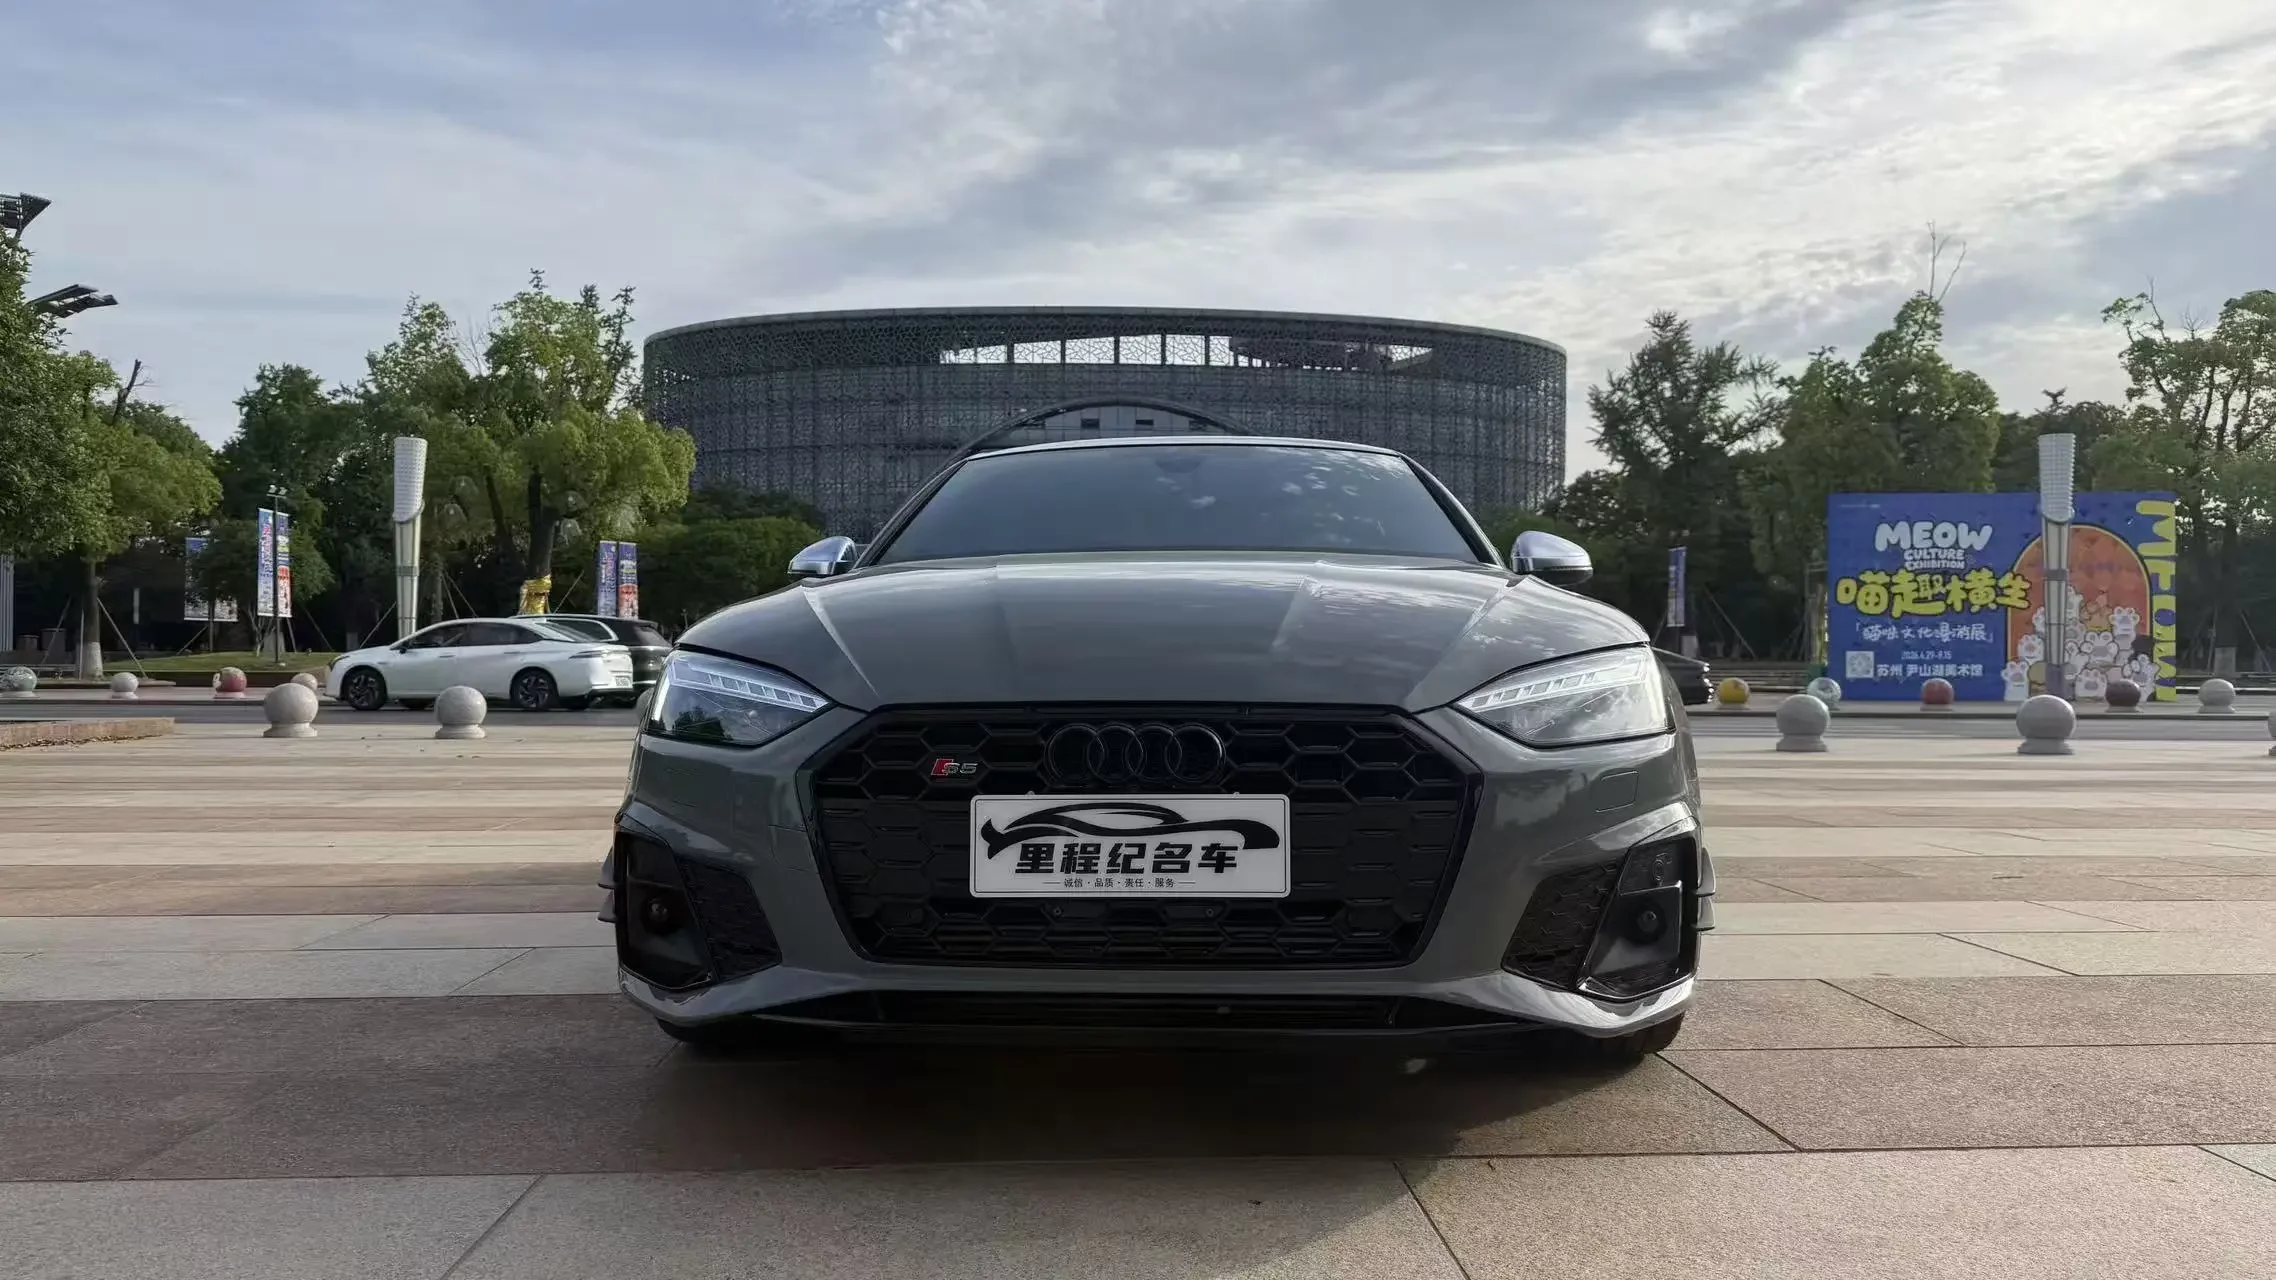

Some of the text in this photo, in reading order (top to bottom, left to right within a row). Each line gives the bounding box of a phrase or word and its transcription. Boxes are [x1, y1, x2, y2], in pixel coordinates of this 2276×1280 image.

[1875, 521, 1993, 551] MEOW
[1904, 548, 1965, 560] CULTURE
[1905, 559, 1965, 570] EXHIBITION
[1836, 567, 2032, 619] 喵趣横生
[1877, 664, 1983, 677] 苏州 尹山湖美术馆
[942, 762, 979, 775] S5
[1015, 842, 1239, 875] 里程纪名车
